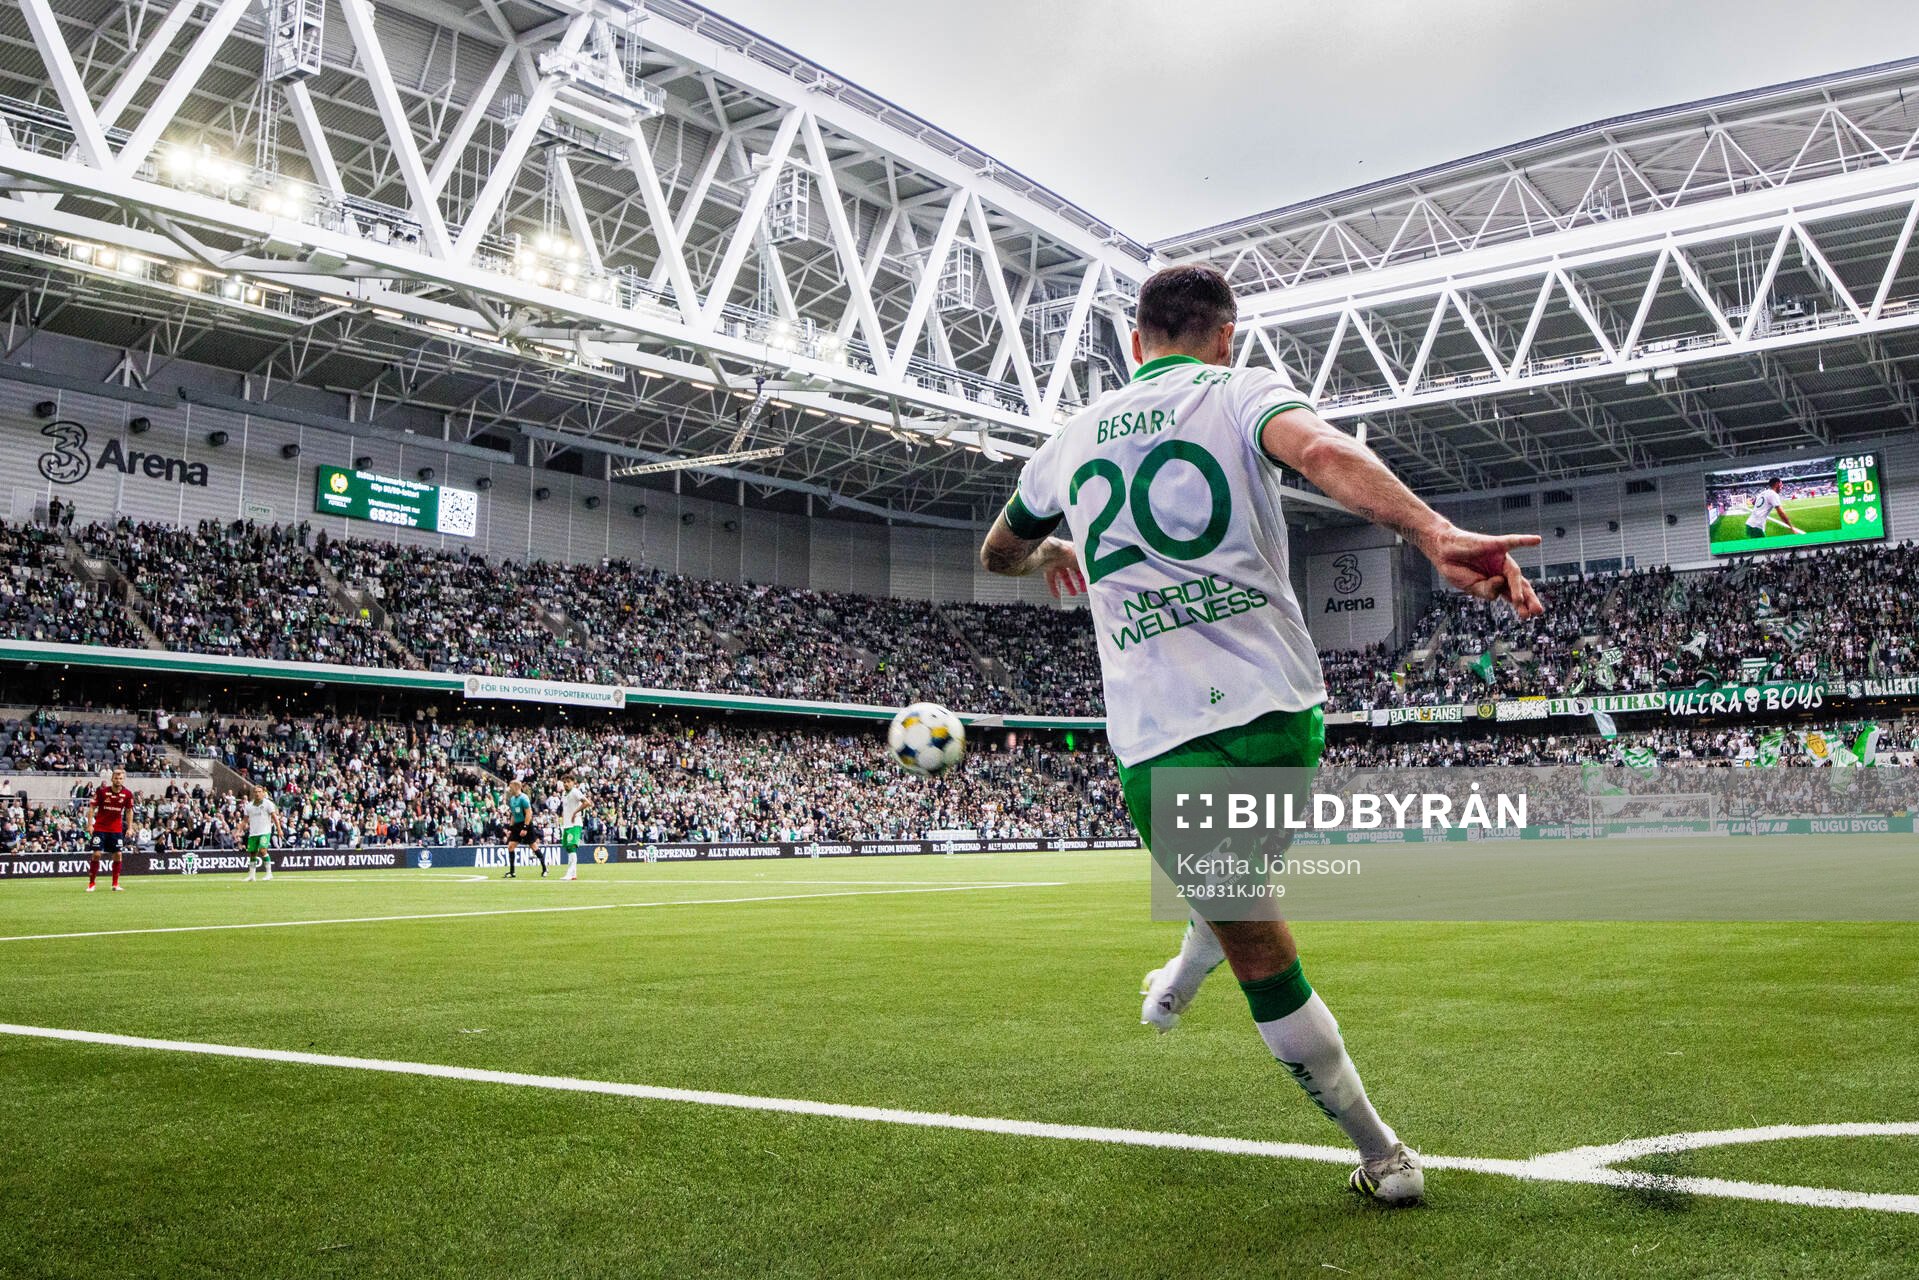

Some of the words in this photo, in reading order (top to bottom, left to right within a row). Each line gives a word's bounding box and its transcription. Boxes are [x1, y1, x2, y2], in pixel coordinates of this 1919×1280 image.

[1097, 408, 1176, 444] BESARA
[96, 440, 208, 486] Arena
[1838, 456, 1874, 470] 45:18
[1844, 482, 1853, 496] 3
[1864, 480, 1873, 493] 0
[370, 508, 408, 526] 69325
[408, 516, 418, 526] kr
[1070, 440, 1232, 585] 20
[1123, 574, 1233, 620] NORDIC
[1325, 597, 1374, 613] Arena
[1112, 588, 1268, 651] WELLNESS
[513, 687, 541, 695] POSITIV
[544, 690, 611, 700] SUPPORTERKULTUR
[1669, 690, 1742, 716] ULTRA
[1763, 685, 1825, 711] BOYS
[1592, 694, 1663, 711] ULTRAS
[1391, 709, 1420, 723] BAJEN
[1431, 708, 1455, 720] FANS
[1548, 827, 1604, 836] INTESPORT
[1772, 822, 1788, 832] AB
[1811, 820, 1848, 832] RUGU
[1852, 820, 1888, 831] BYGG
[708, 848, 728, 857] ALLT
[729, 848, 750, 857] INOM
[750, 847, 780, 856] RIVNING
[861, 845, 878, 854] ALLT
[12, 861, 54, 874] INOM
[58, 860, 114, 872] RIVNN
[149, 858, 165, 870] R1
[281, 856, 311, 868] ALLT
[314, 855, 346, 867] INOM
[348, 854, 395, 866] RIVNING
